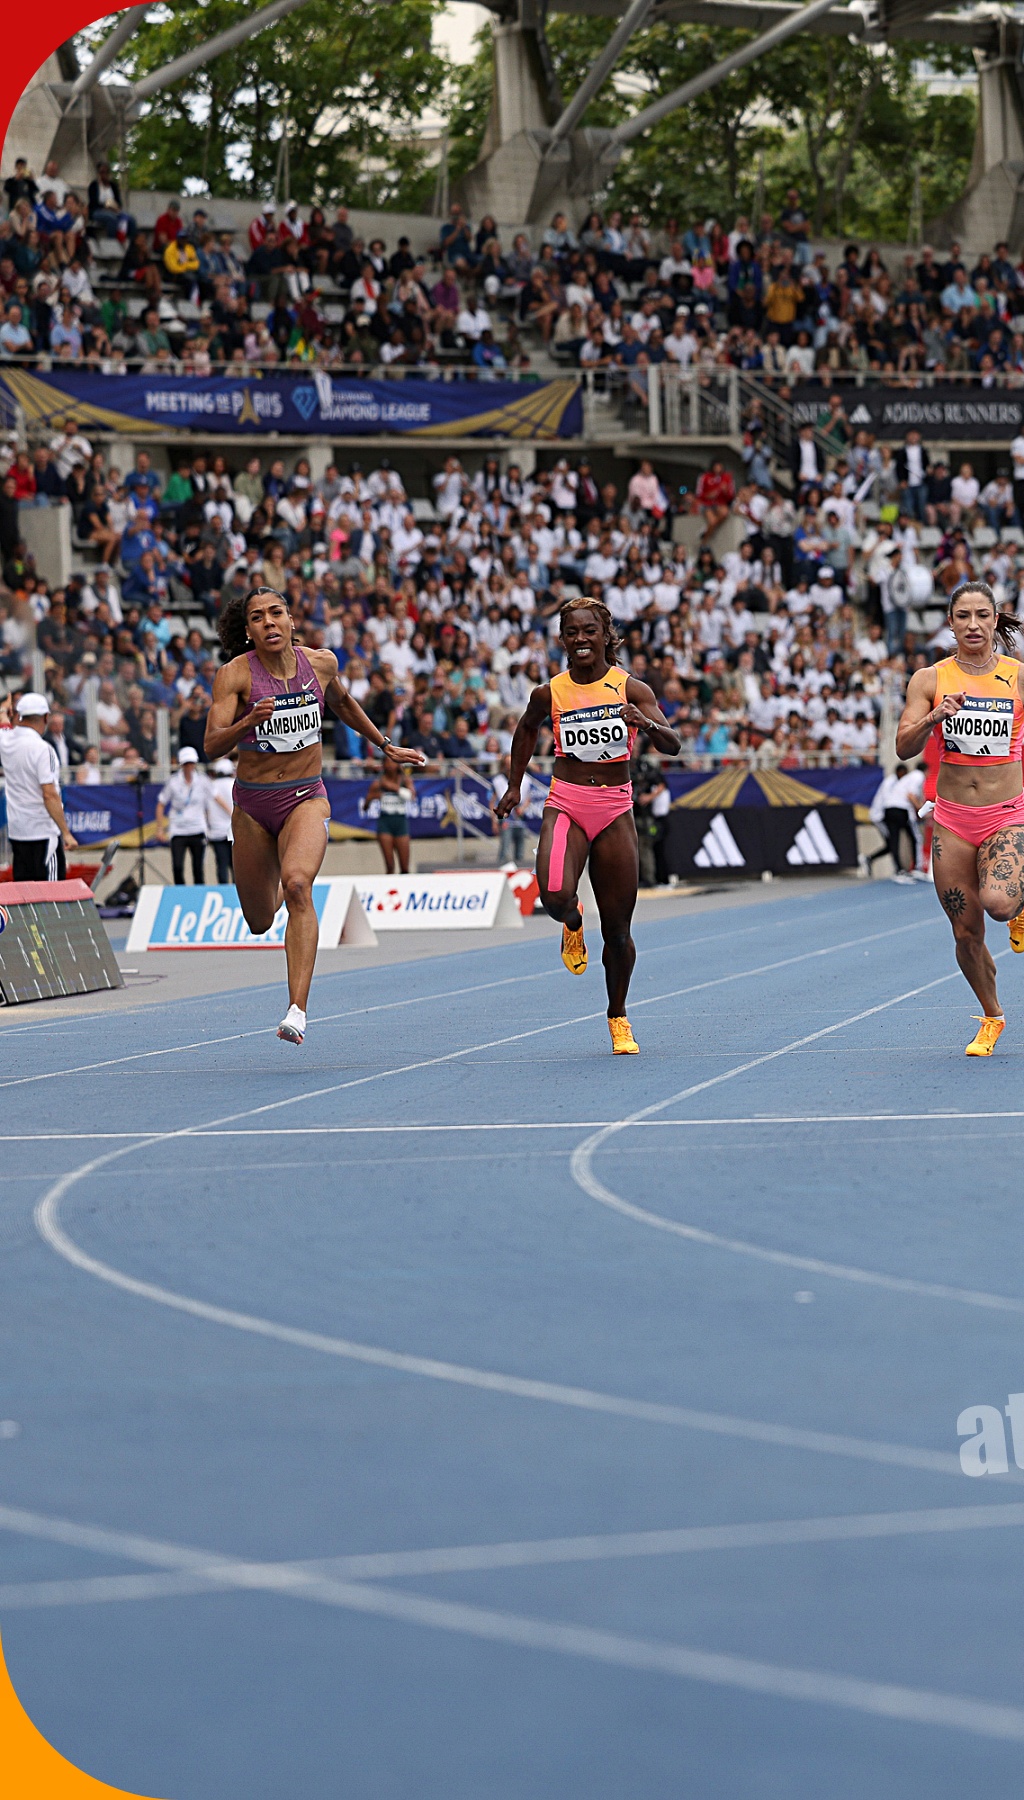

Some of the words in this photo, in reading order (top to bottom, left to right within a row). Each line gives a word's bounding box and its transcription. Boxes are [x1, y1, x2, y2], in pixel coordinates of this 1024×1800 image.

[145, 390, 215, 413] MEETING
[232, 388, 284, 422] PARIS
[381, 402, 431, 421] LEAGUE
[883, 402, 943, 424] ADIDAS
[944, 402, 1022, 424] RUNNERS
[986, 700, 1012, 711] PARIS
[258, 711, 319, 735] KAMBUNDJI
[561, 711, 591, 722] MEETING
[945, 717, 1009, 737] SWOBODA
[565, 725, 623, 746] DOSSO
[71, 811, 111, 832] LEAGUE
[405, 890, 489, 912] Mutuel
[166, 904, 197, 943] Le
